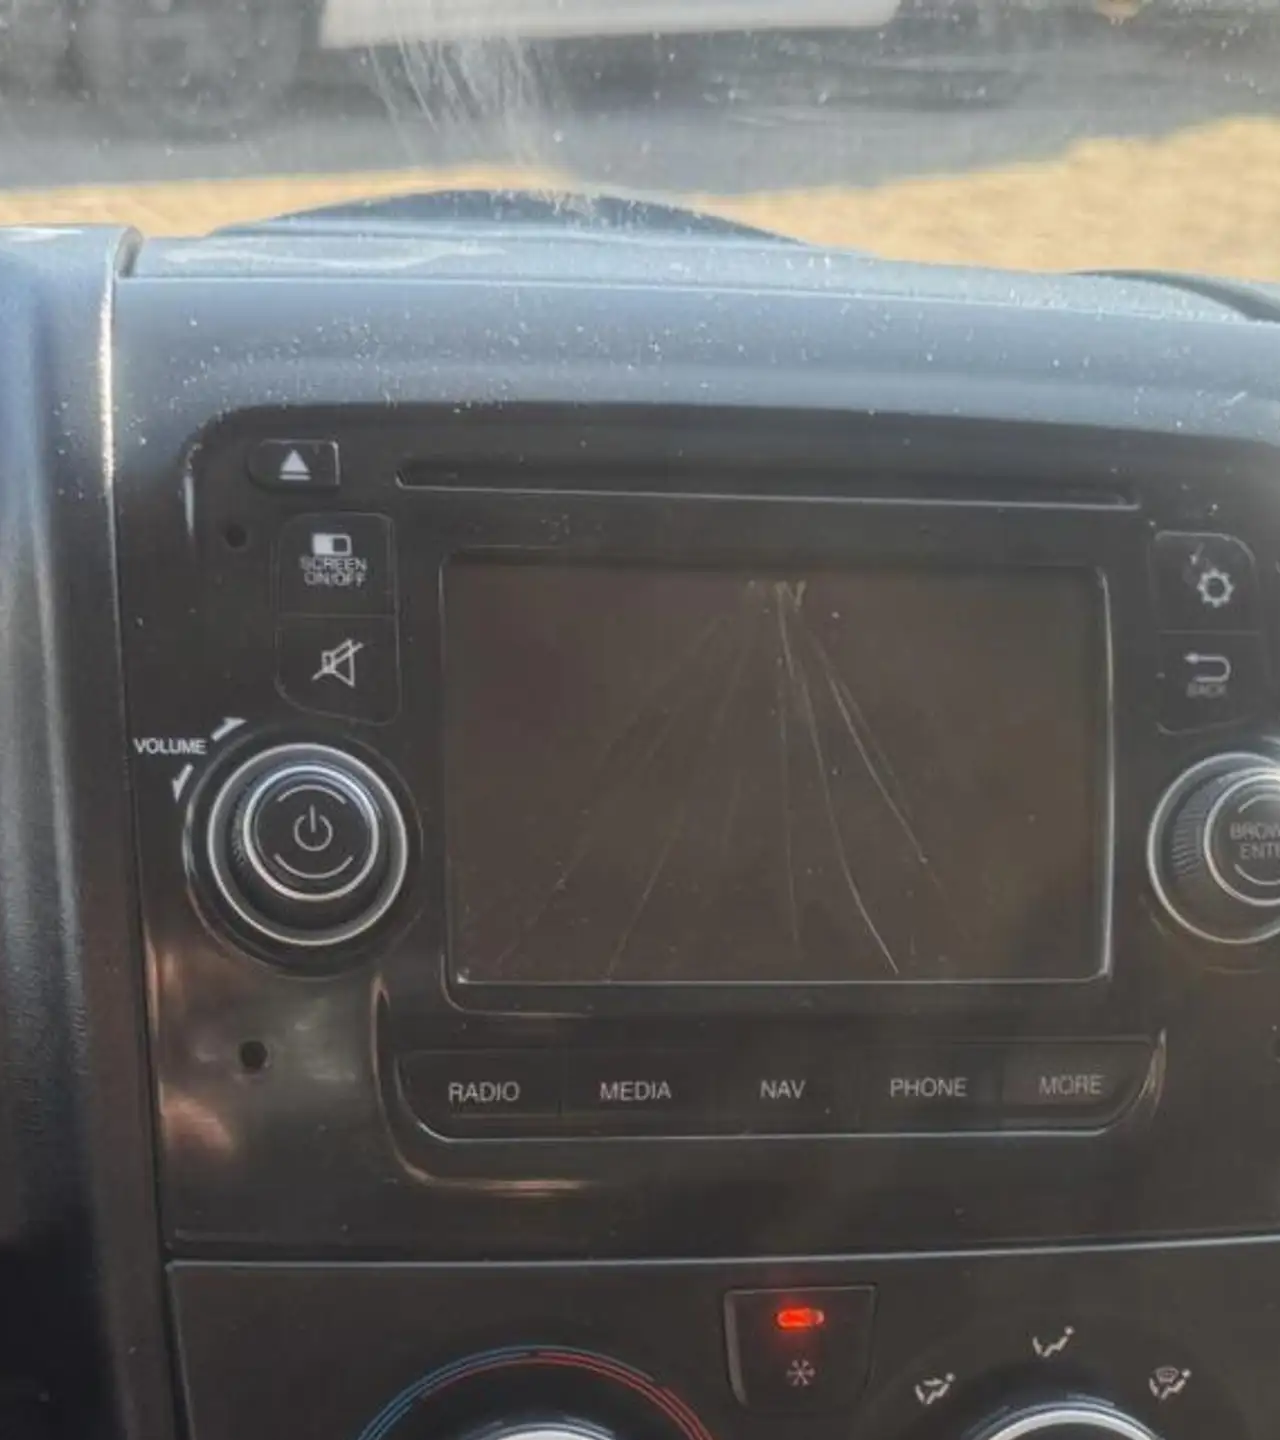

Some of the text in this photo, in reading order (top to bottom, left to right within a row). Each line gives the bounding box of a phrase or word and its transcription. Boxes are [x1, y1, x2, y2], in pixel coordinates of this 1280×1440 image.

[299, 556, 368, 573] SCREEN
[303, 572, 367, 588] ON/OFF
[133, 737, 207, 756] VOLUME
[447, 1080, 521, 1103] RADIO
[599, 1079, 673, 1102] MEDIA
[759, 1079, 806, 1101] NAV
[889, 1076, 968, 1099] PHONE
[1038, 1073, 1103, 1096] MORE
